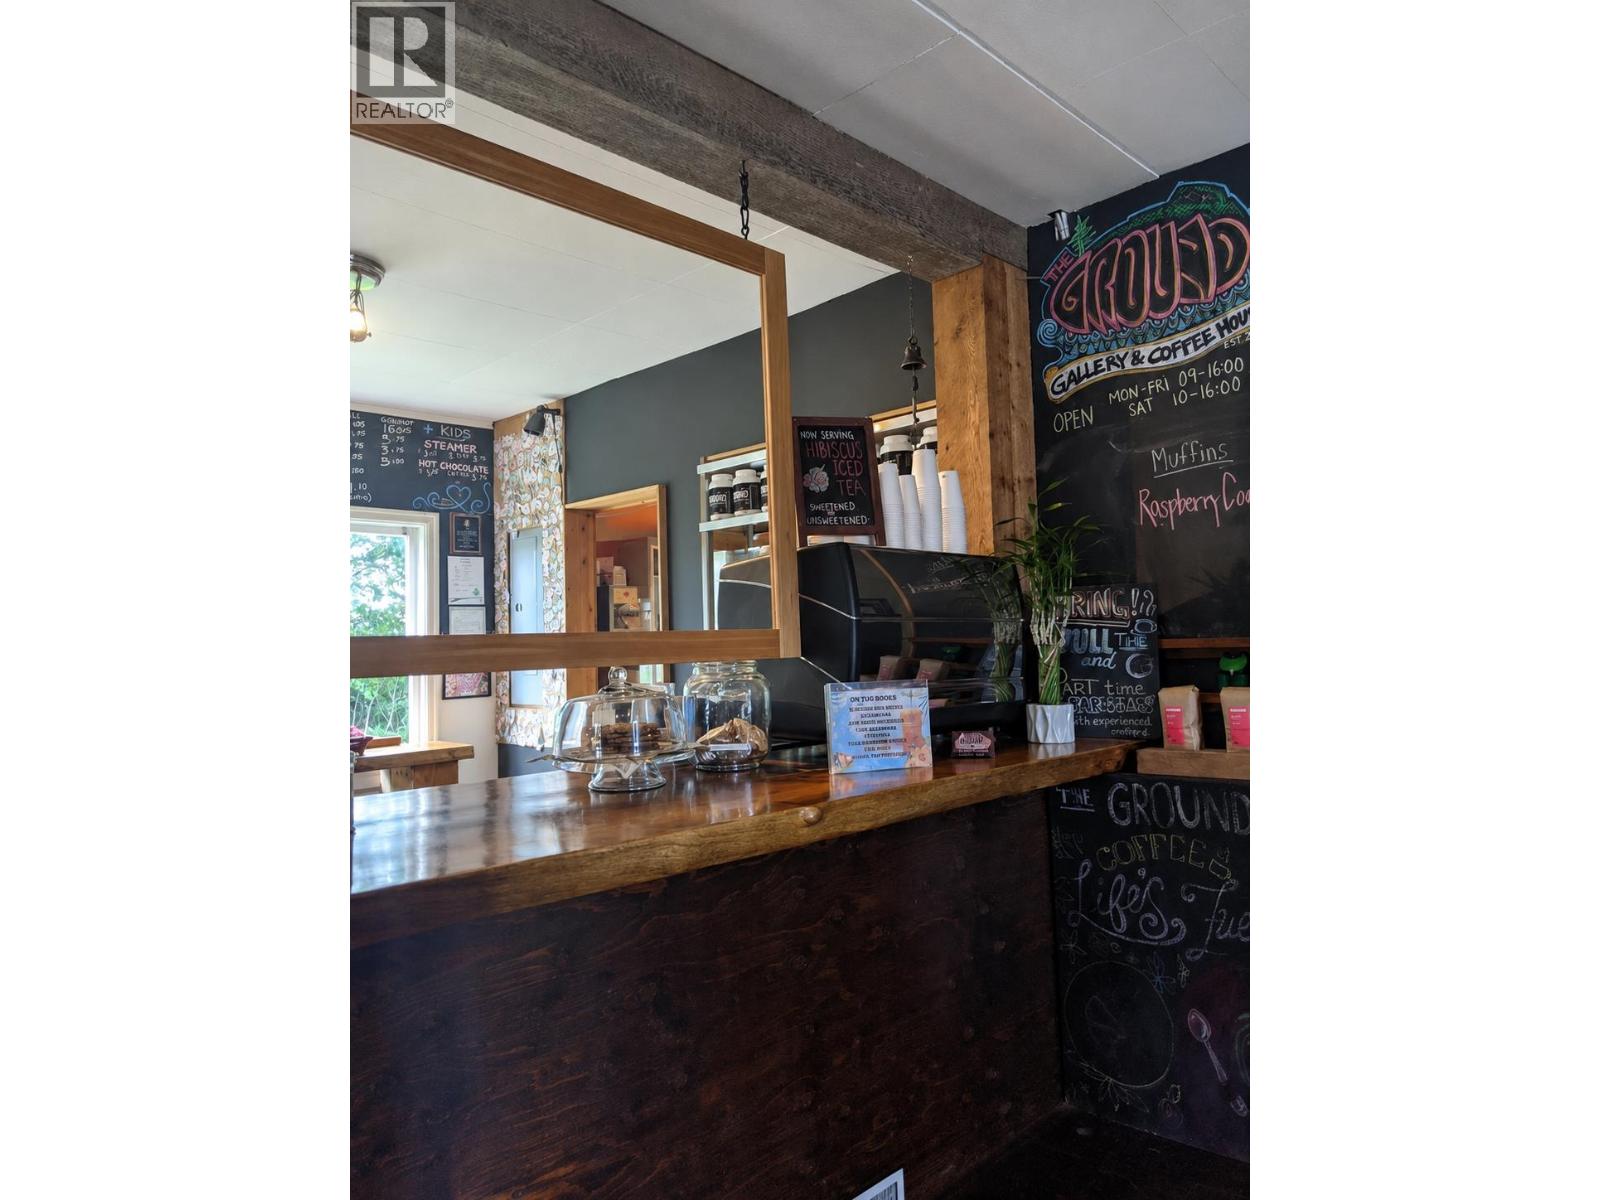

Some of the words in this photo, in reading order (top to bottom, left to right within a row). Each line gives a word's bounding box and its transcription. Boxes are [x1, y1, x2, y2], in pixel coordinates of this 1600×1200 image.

[1045, 252, 1074, 282] THE
[1051, 213, 1250, 334] GROUND
[1051, 355, 1128, 395] GALLERY
[1131, 350, 1146, 366] &
[1149, 327, 1217, 365] COFFEE
[1215, 307, 1250, 338] HOU
[1224, 335, 1242, 349] EST
[1108, 376, 1170, 405] MON-FRI
[1178, 357, 1244, 387] 09-16:00
[1128, 397, 1154, 417] SAT
[1173, 376, 1241, 406] 10-16:00
[1053, 405, 1094, 432] OPEN
[440, 424, 472, 440] KIDS
[800, 431, 819, 440] NOW
[821, 430, 855, 441] SERVING
[424, 440, 477, 454] STEAMER
[805, 440, 864, 459] HIBISCUS
[418, 459, 438, 469] HOT
[440, 462, 489, 474] CHOCOLATE
[1151, 441, 1228, 473] Muffins
[833, 460, 863, 477] ICED
[836, 479, 866, 497] TEA
[809, 501, 856, 512] SWEETENED
[1138, 488, 1221, 530] Raspberry
[1114, 632, 1149, 647] THE
[1081, 651, 1118, 670] and
[1104, 680, 1146, 695] time
[1074, 716, 1091, 726] ith
[1056, 787, 1094, 807] THE
[1107, 782, 1250, 836] GROUND
[1097, 833, 1207, 871] COFFEE
